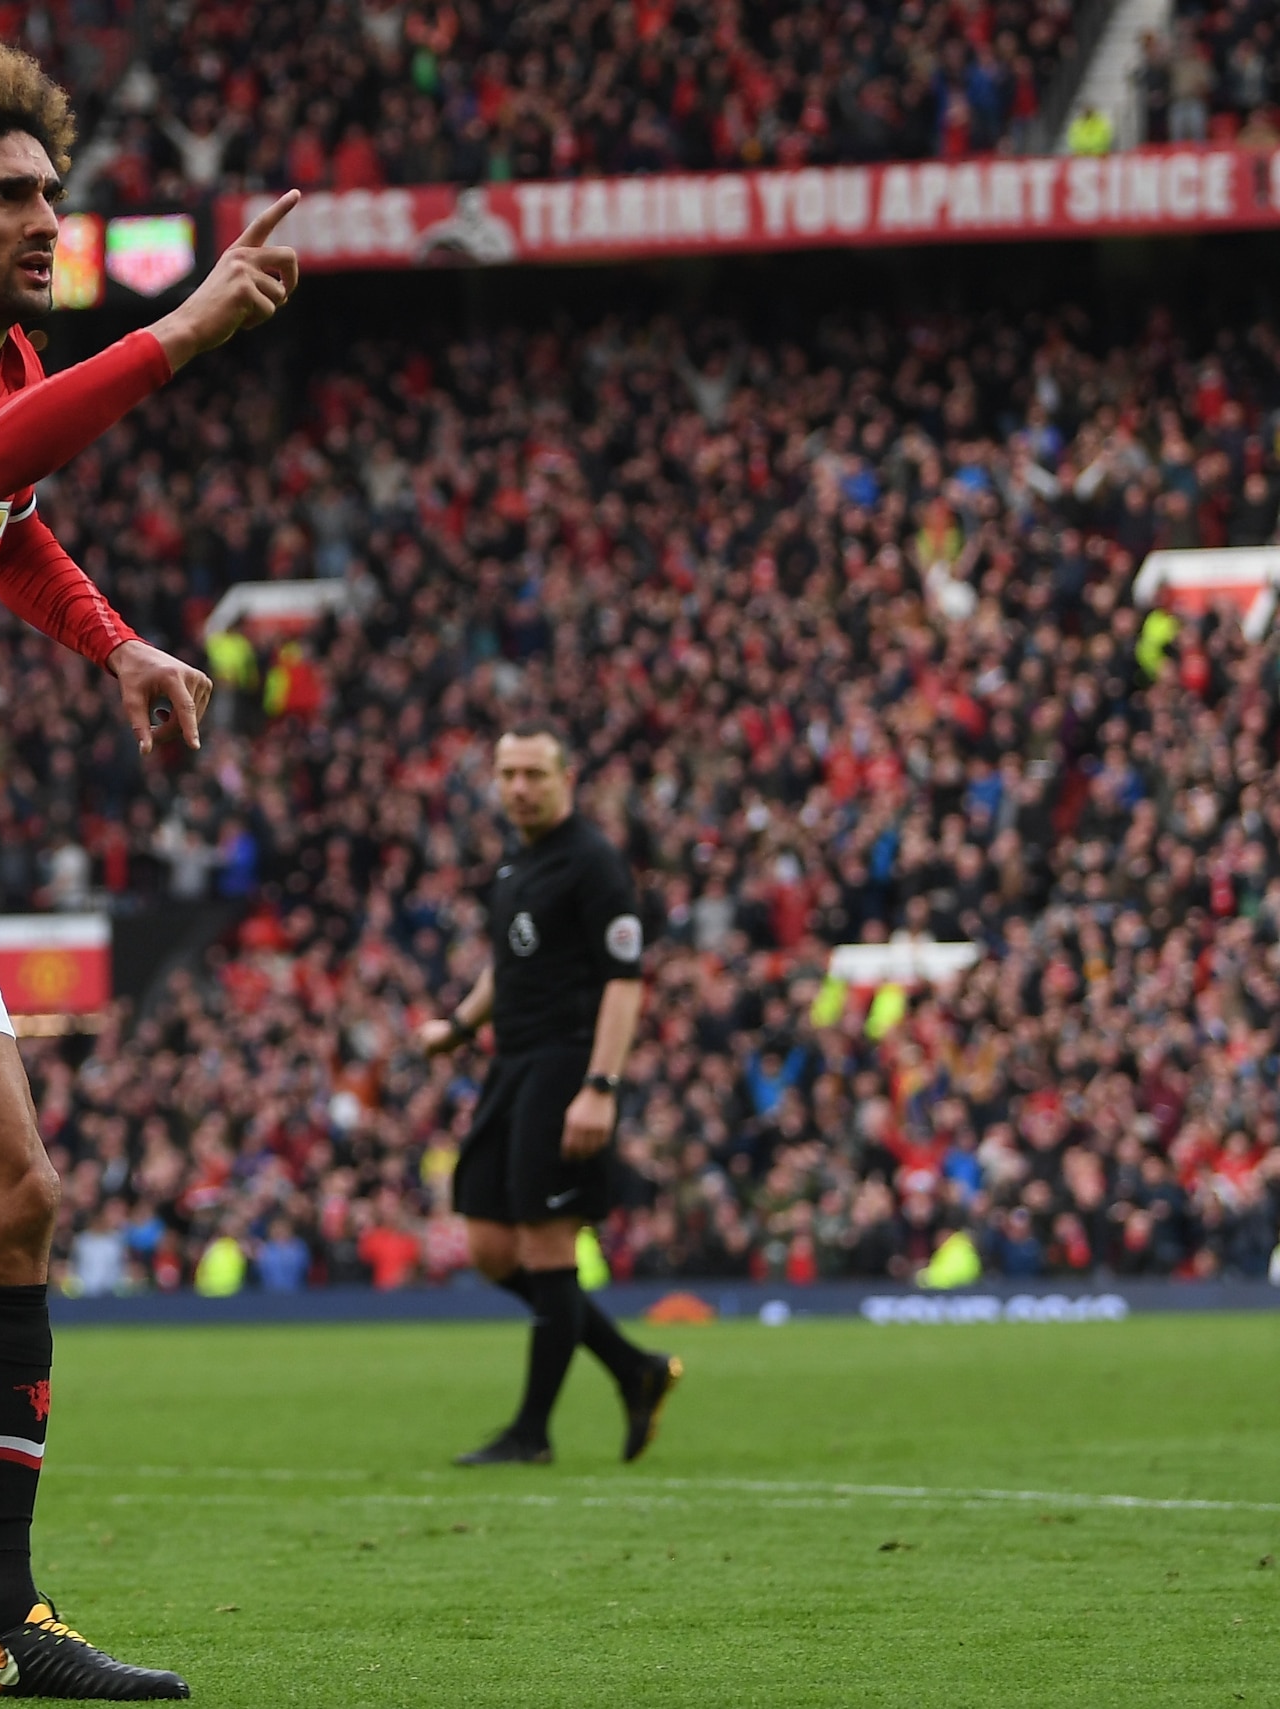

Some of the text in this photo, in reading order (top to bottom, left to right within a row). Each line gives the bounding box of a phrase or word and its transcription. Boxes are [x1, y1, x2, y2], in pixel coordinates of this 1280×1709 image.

[513, 174, 748, 249] TEARING
[756, 166, 868, 238] YOU
[879, 158, 1058, 231] APART
[1065, 151, 1234, 224] SINCE
